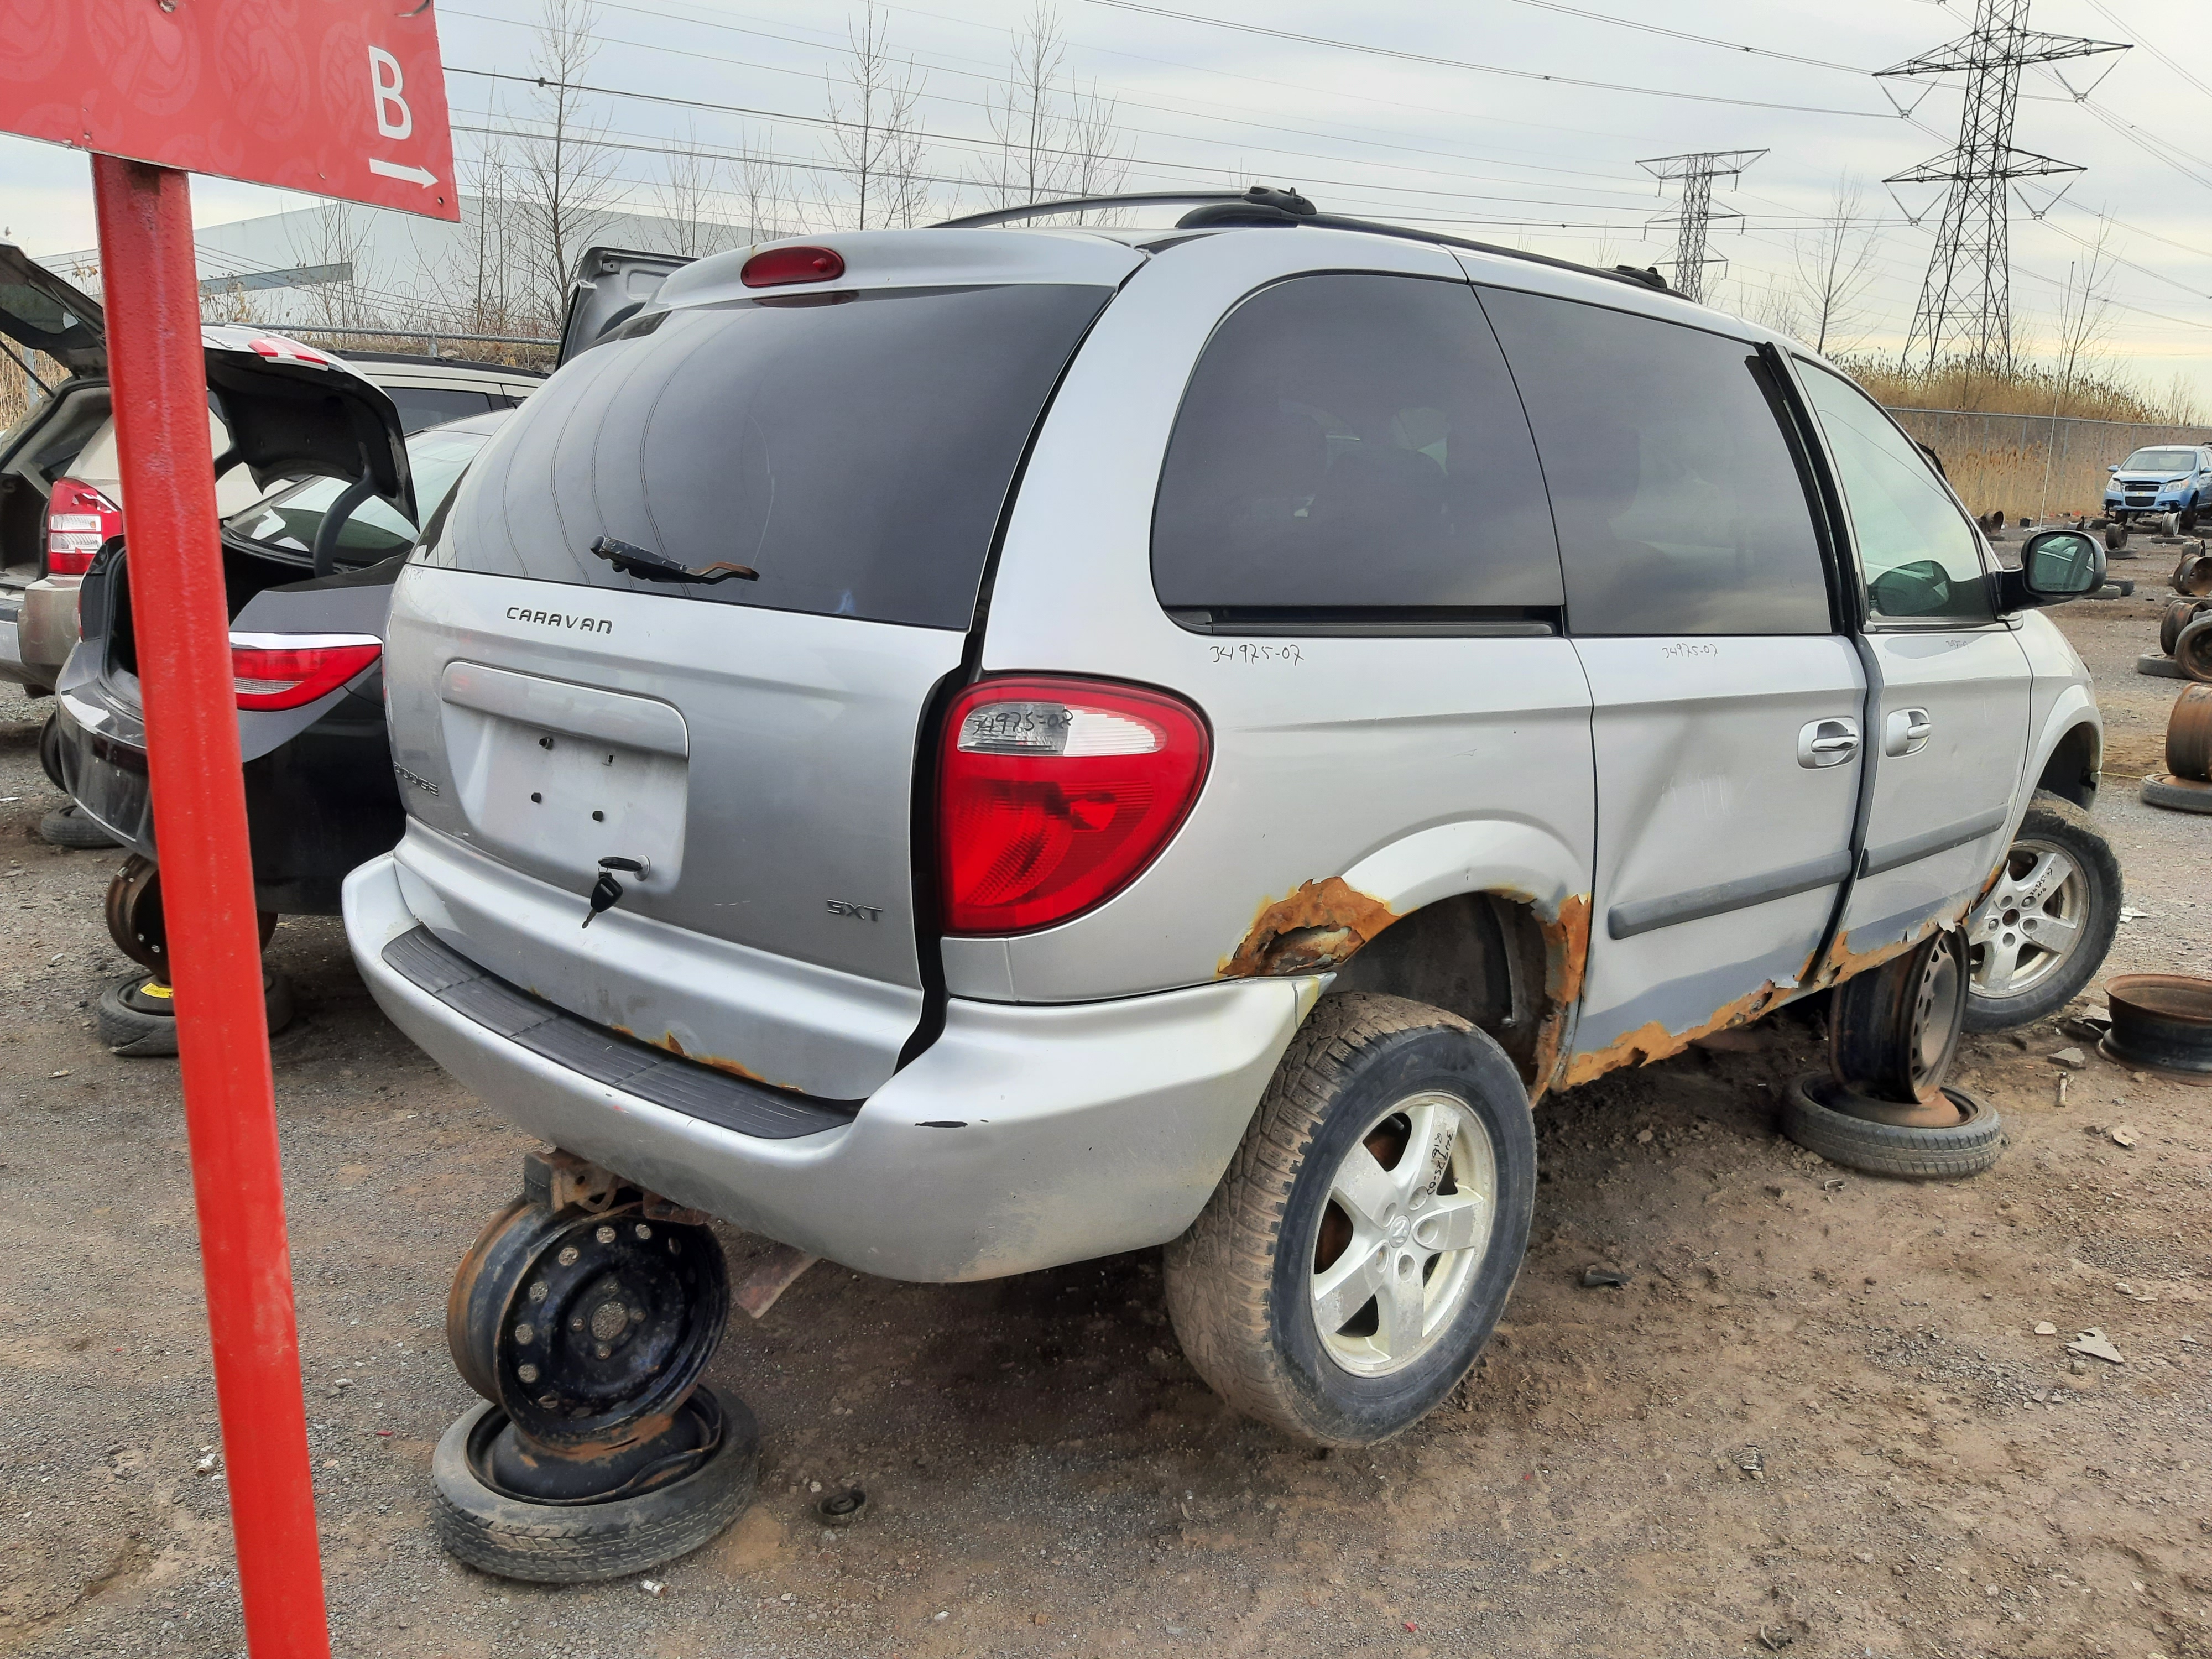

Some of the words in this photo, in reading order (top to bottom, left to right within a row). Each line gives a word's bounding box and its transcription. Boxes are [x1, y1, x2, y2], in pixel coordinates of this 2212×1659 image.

[368, 45, 412, 140] B
[506, 606, 613, 634] CARAVAN
[394, 761, 440, 797] DODGE
[827, 899, 883, 922] SXT
